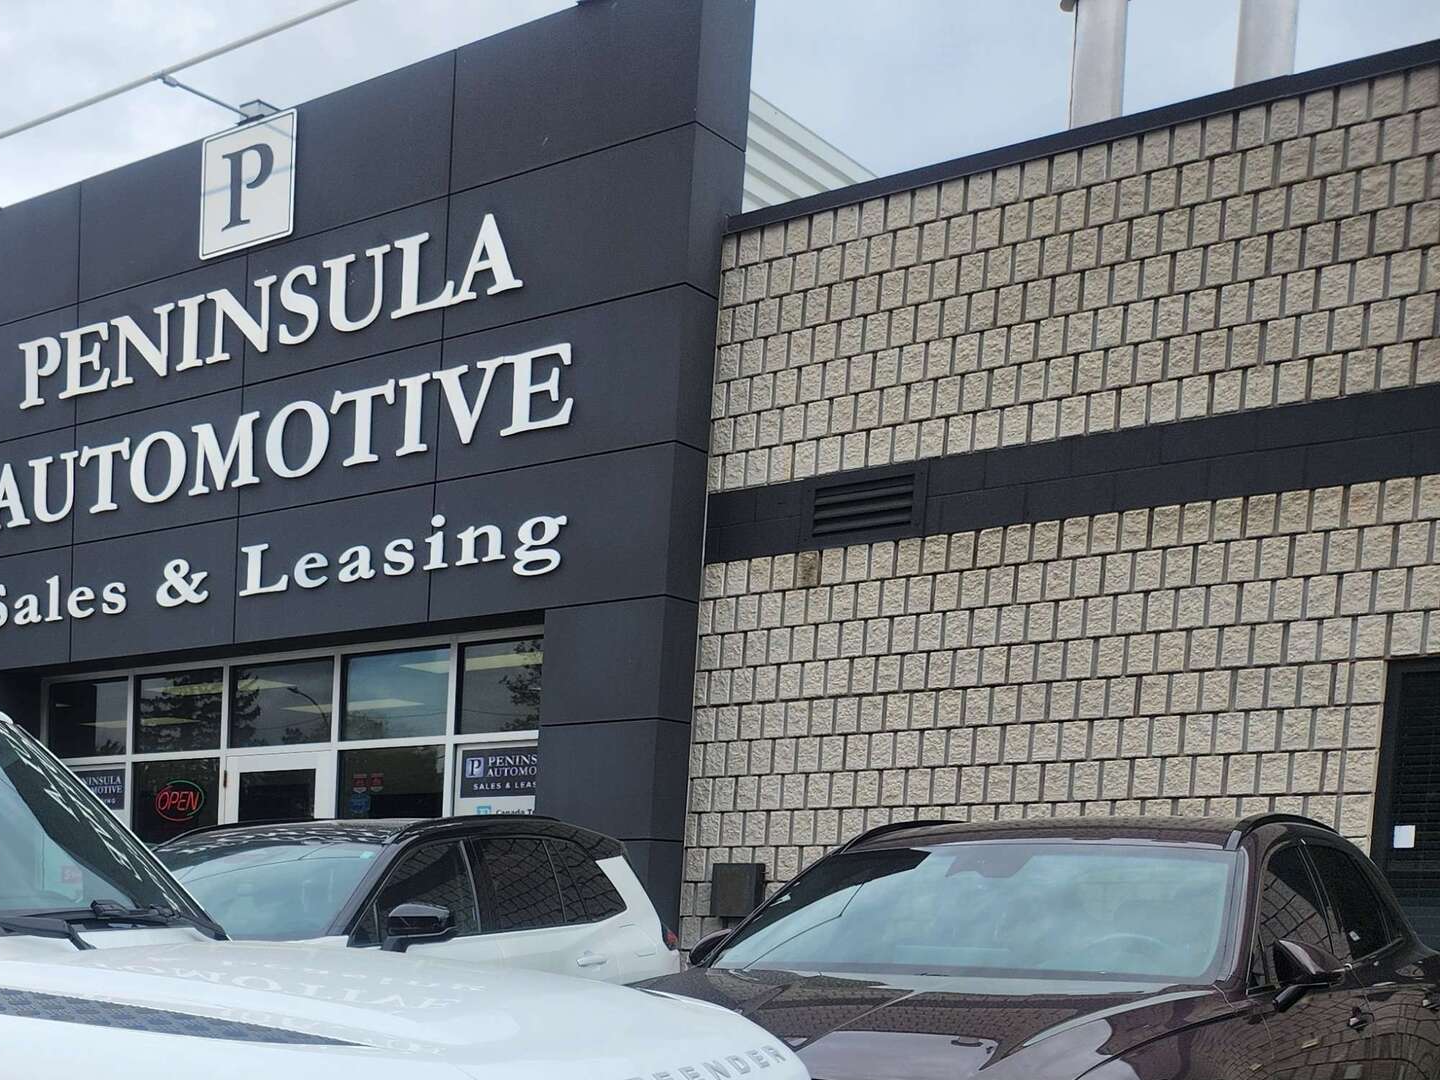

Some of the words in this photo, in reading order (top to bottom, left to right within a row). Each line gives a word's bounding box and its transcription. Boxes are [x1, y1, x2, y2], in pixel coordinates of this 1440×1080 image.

[220, 142, 275, 233] P
[18, 213, 523, 410] PENINSULA
[155, 559, 209, 608] &
[238, 514, 568, 597] Leasing
[488, 754, 537, 767] PENINS
[485, 766, 537, 777] AUTOMO
[81, 775, 121, 786] NINSULA
[473, 783, 501, 791] SALES
[515, 781, 537, 789] LEAS
[90, 785, 123, 794] MOTIVE
[158, 791, 199, 811] OPEN
